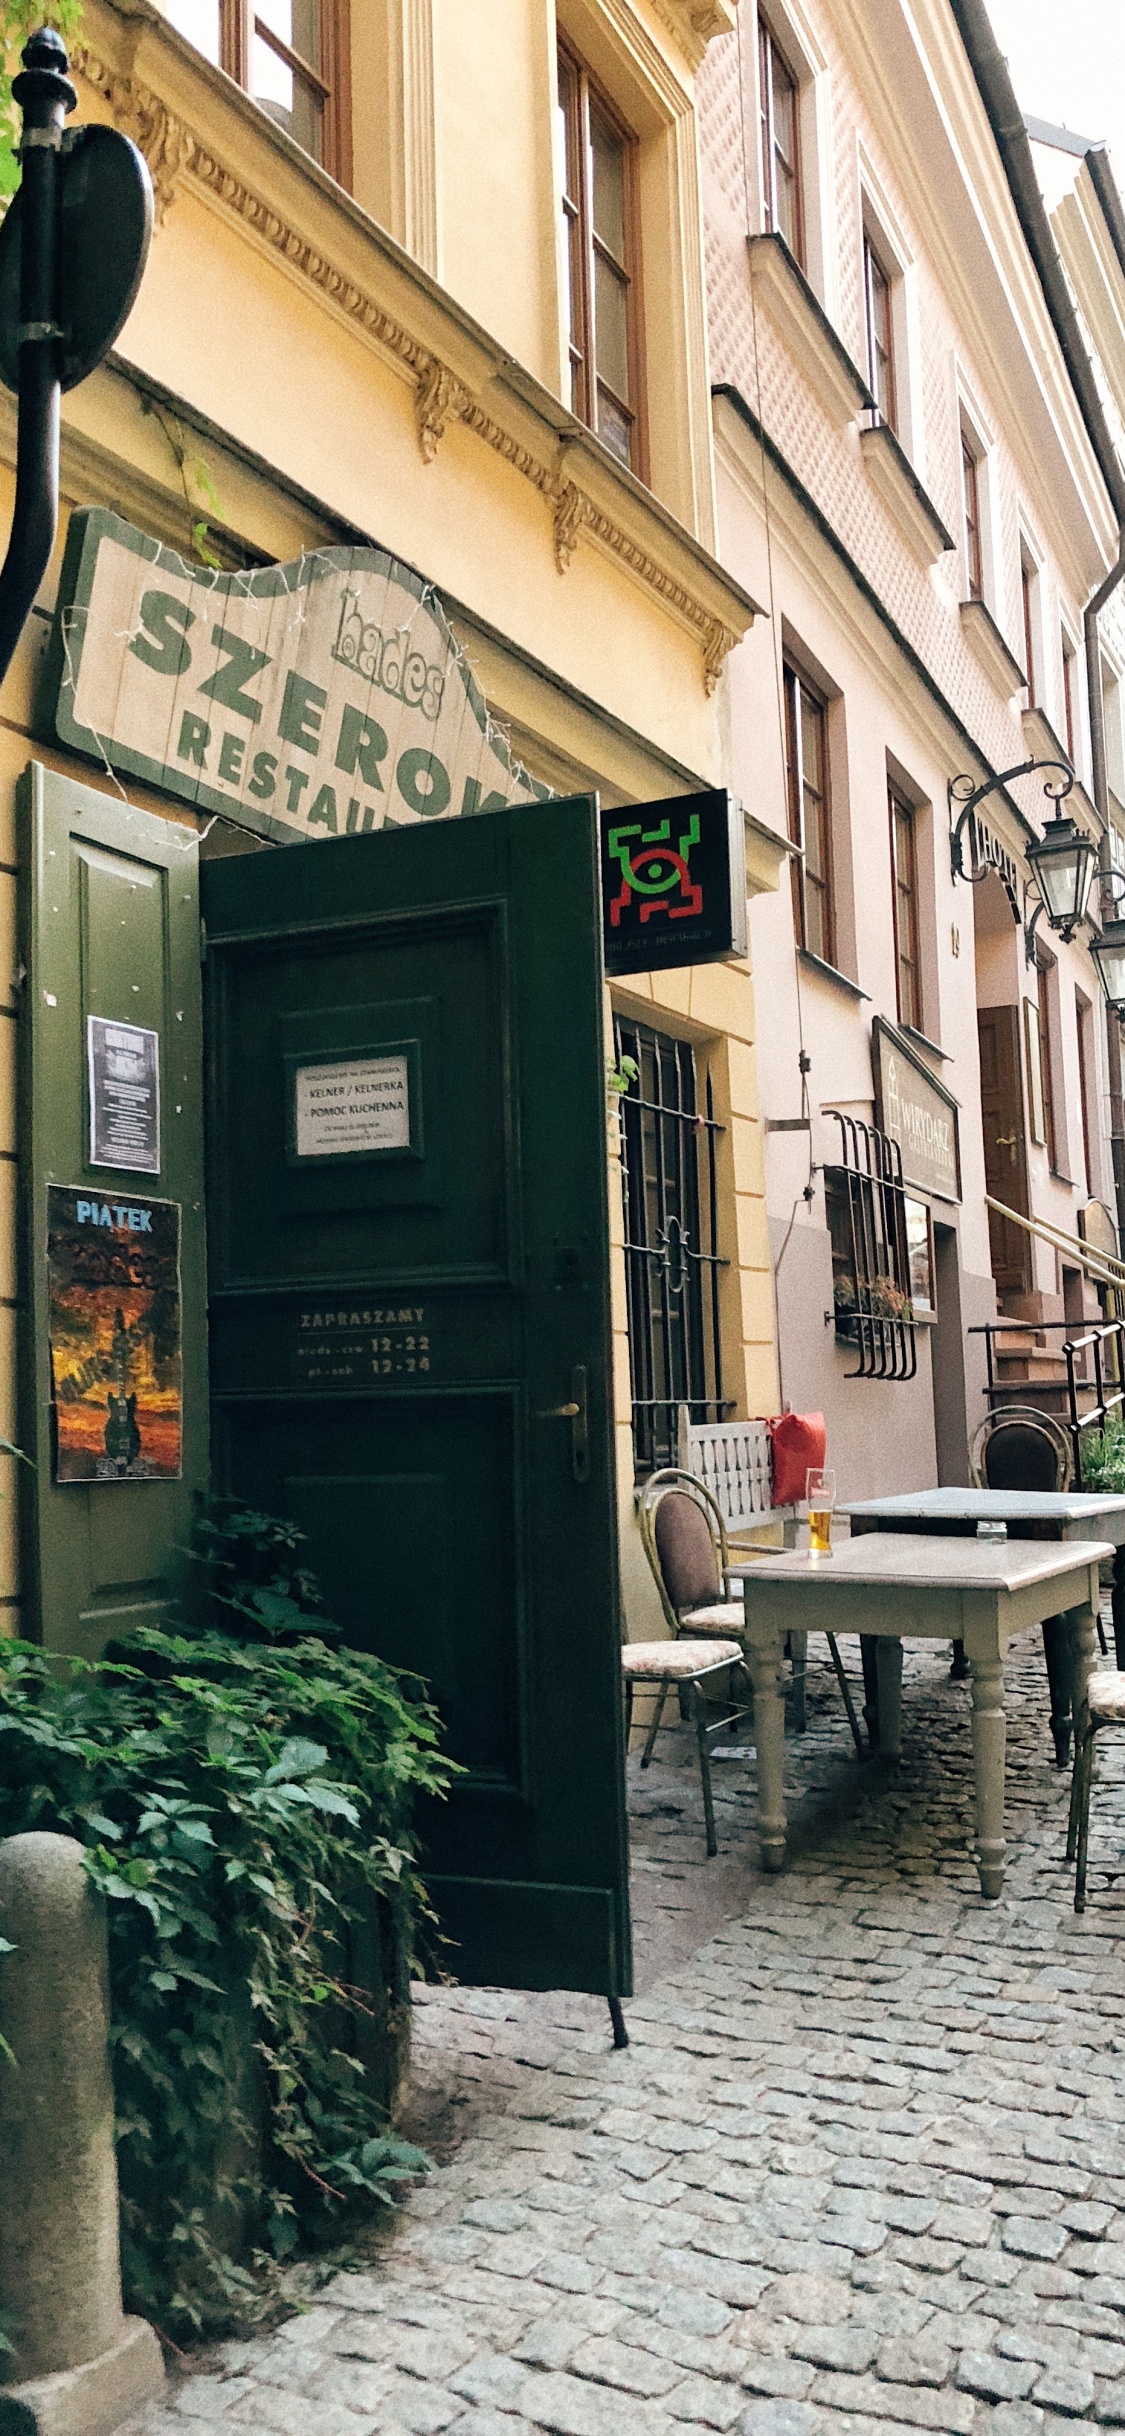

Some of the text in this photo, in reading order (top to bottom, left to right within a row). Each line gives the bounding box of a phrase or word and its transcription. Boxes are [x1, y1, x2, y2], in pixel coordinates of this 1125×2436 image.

[177, 710, 401, 834] RESTAU
[309, 1086, 345, 1098] KELNER
[354, 1081, 404, 1094] KELNERKA
[310, 1101, 404, 1118] POMOC KUCHENNA
[901, 1098, 949, 1151] WIRYDARZ
[76, 1200, 153, 1233] PIĄTEK
[300, 1308, 424, 1327] ZAPRASZAMY
